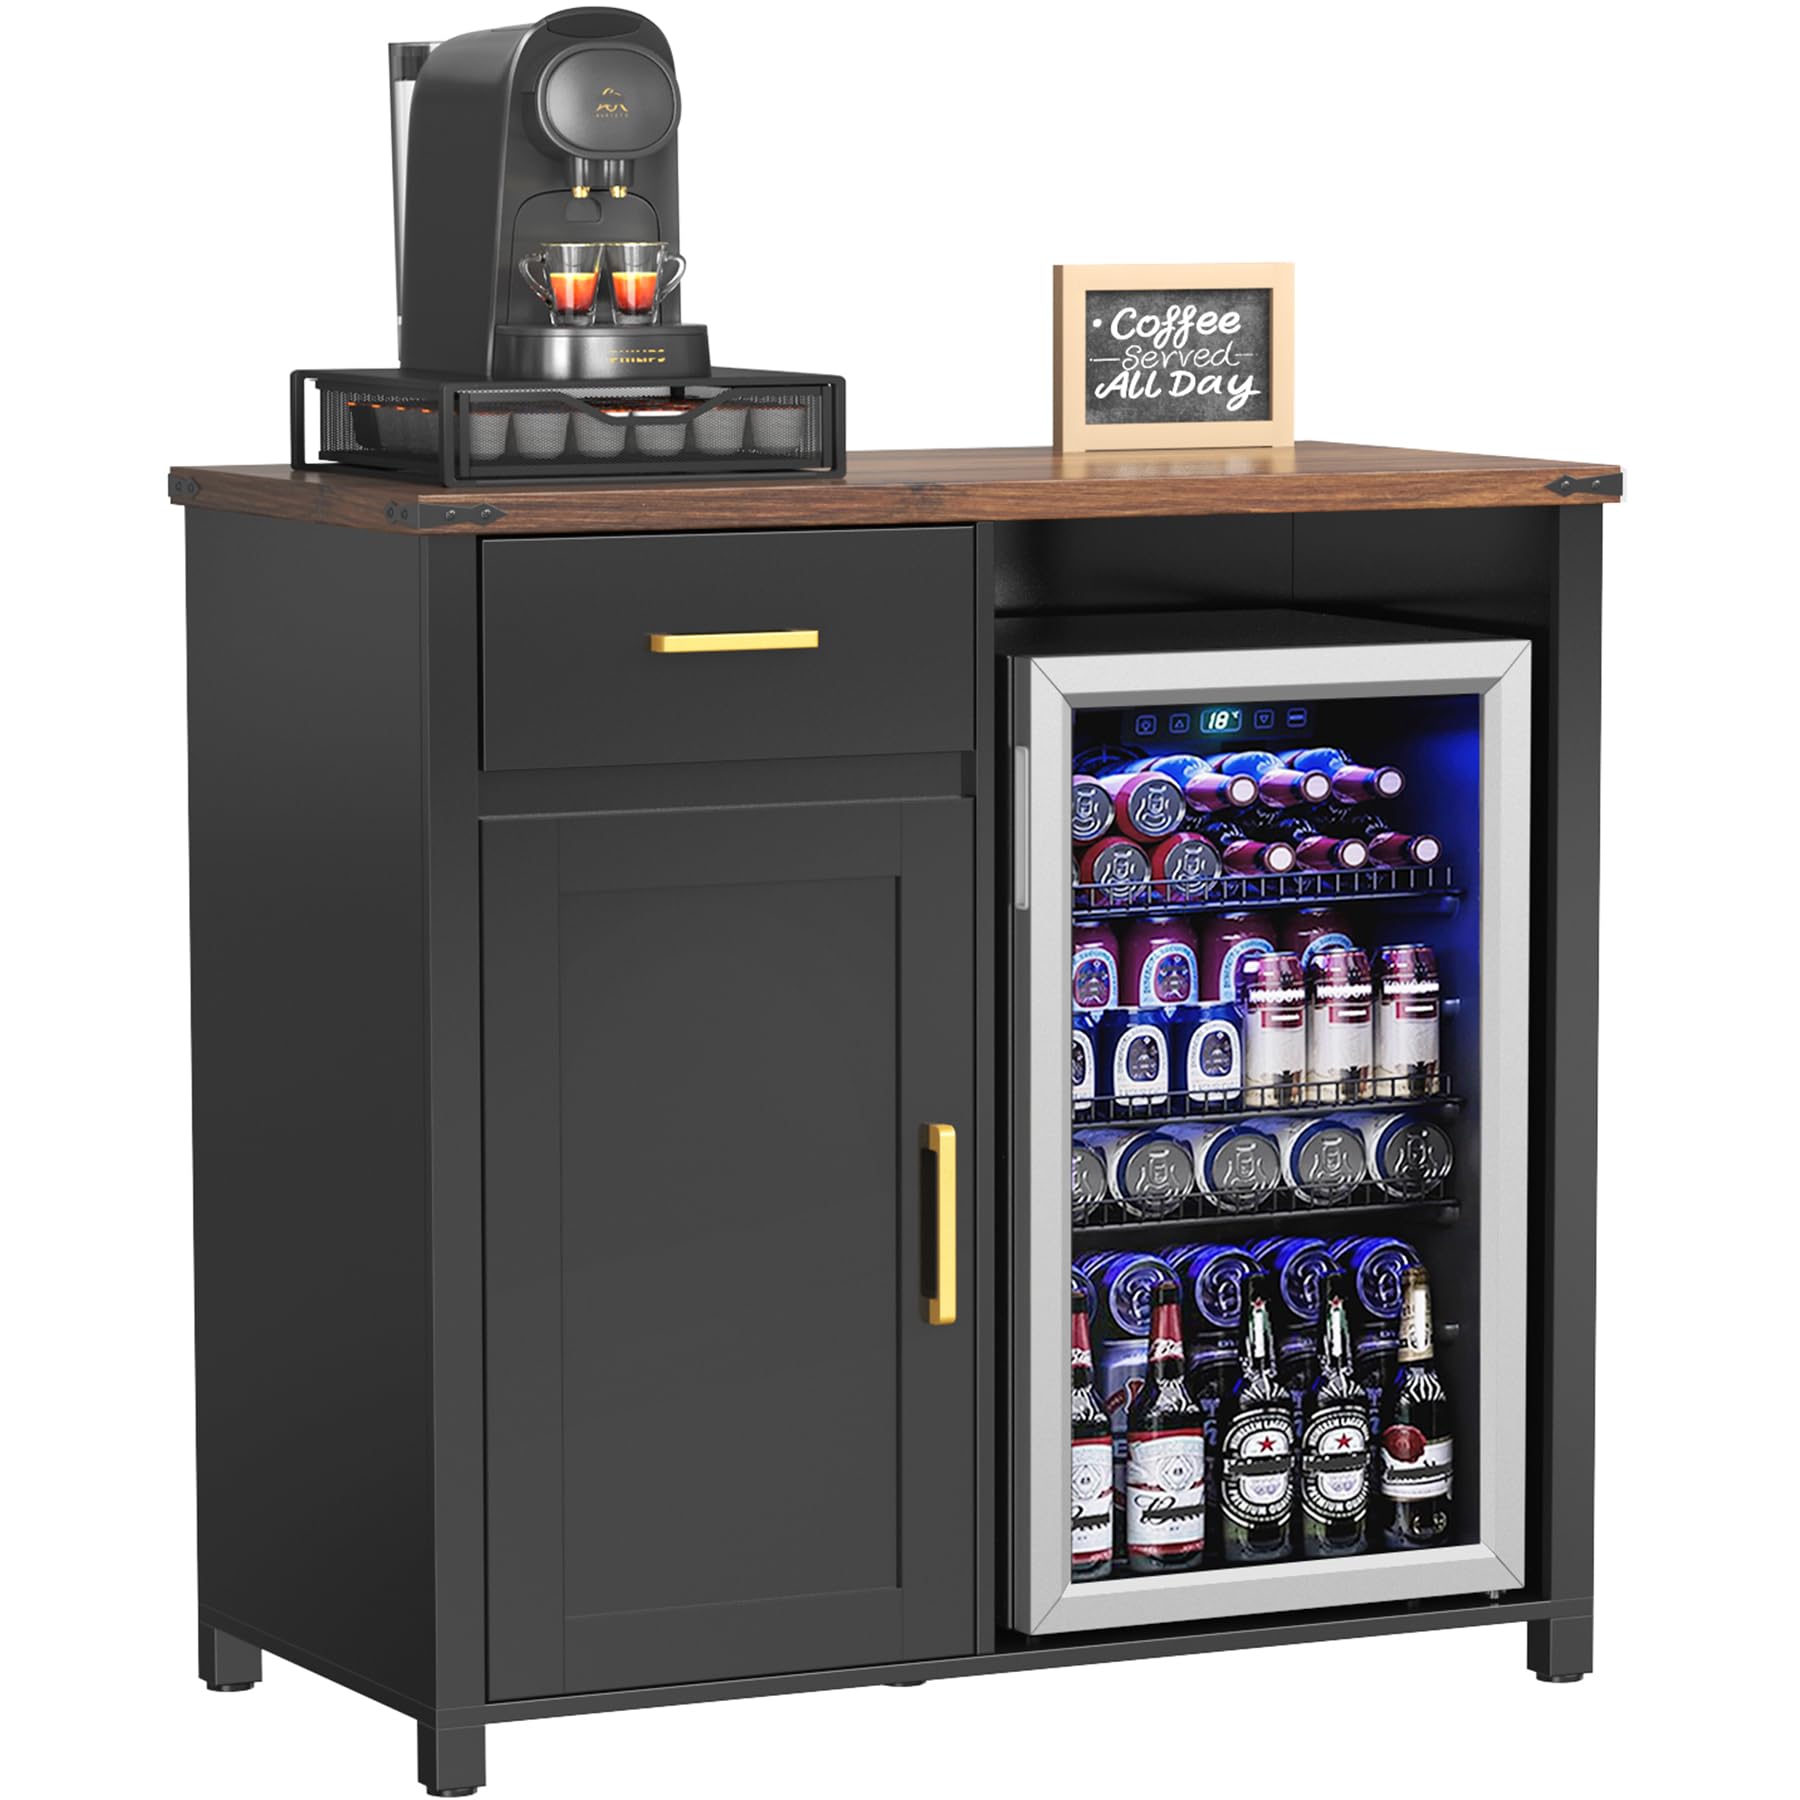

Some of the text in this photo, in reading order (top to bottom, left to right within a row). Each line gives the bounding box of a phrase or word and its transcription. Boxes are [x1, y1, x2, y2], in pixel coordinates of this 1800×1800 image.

[1110, 304, 1242, 349] Coffee
[1121, 340, 1241, 371] Served
[1094, 369, 1262, 412] All Day
